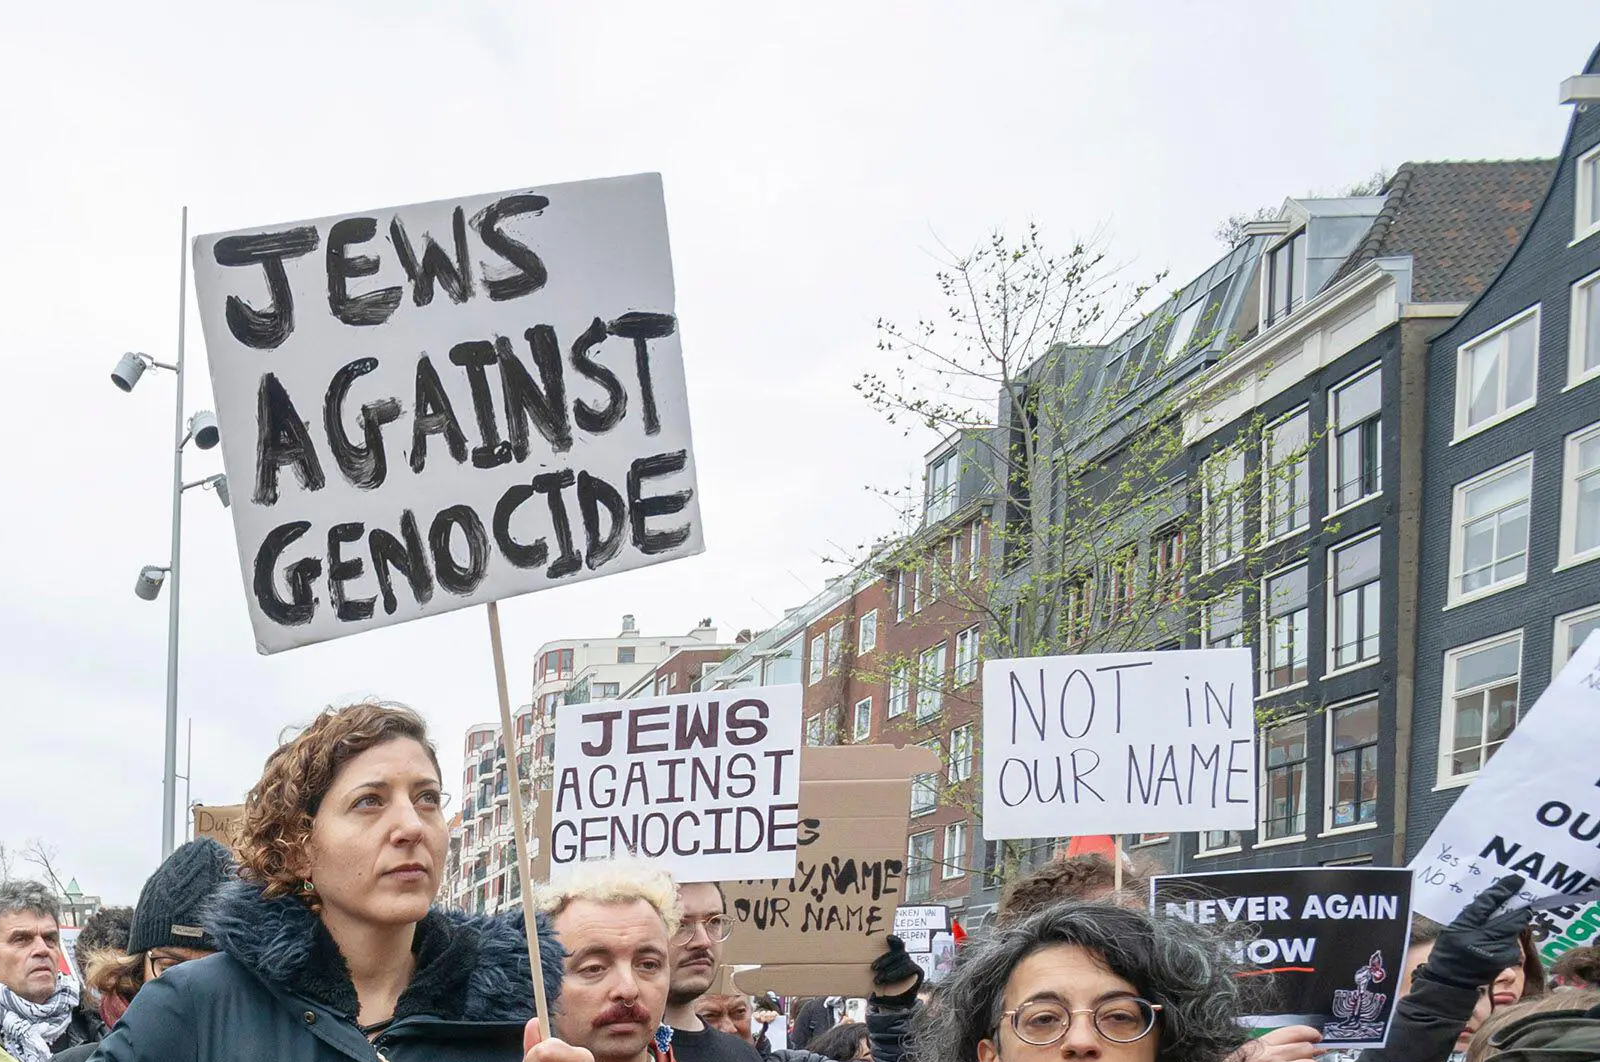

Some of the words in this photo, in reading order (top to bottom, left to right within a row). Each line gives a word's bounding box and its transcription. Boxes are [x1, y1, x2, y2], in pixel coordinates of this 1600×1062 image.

[213, 192, 550, 350] JEWS
[251, 310, 676, 506] AGAINST
[253, 449, 693, 626] GENOCIDE
[581, 698, 770, 757] JEWS
[1009, 661, 1153, 745] NOT
[556, 749, 794, 812] AGAINST
[999, 748, 1106, 807] OUR
[1127, 739, 1250, 808] NAME
[551, 803, 799, 864] GENOCIDE
[1536, 800, 1600, 849] OU
[821, 856, 903, 901] NAME
[1165, 896, 1292, 924] NEVER
[1301, 893, 1398, 920] AGAIN
[734, 896, 790, 931] OUR
[801, 902, 885, 937] NAME
